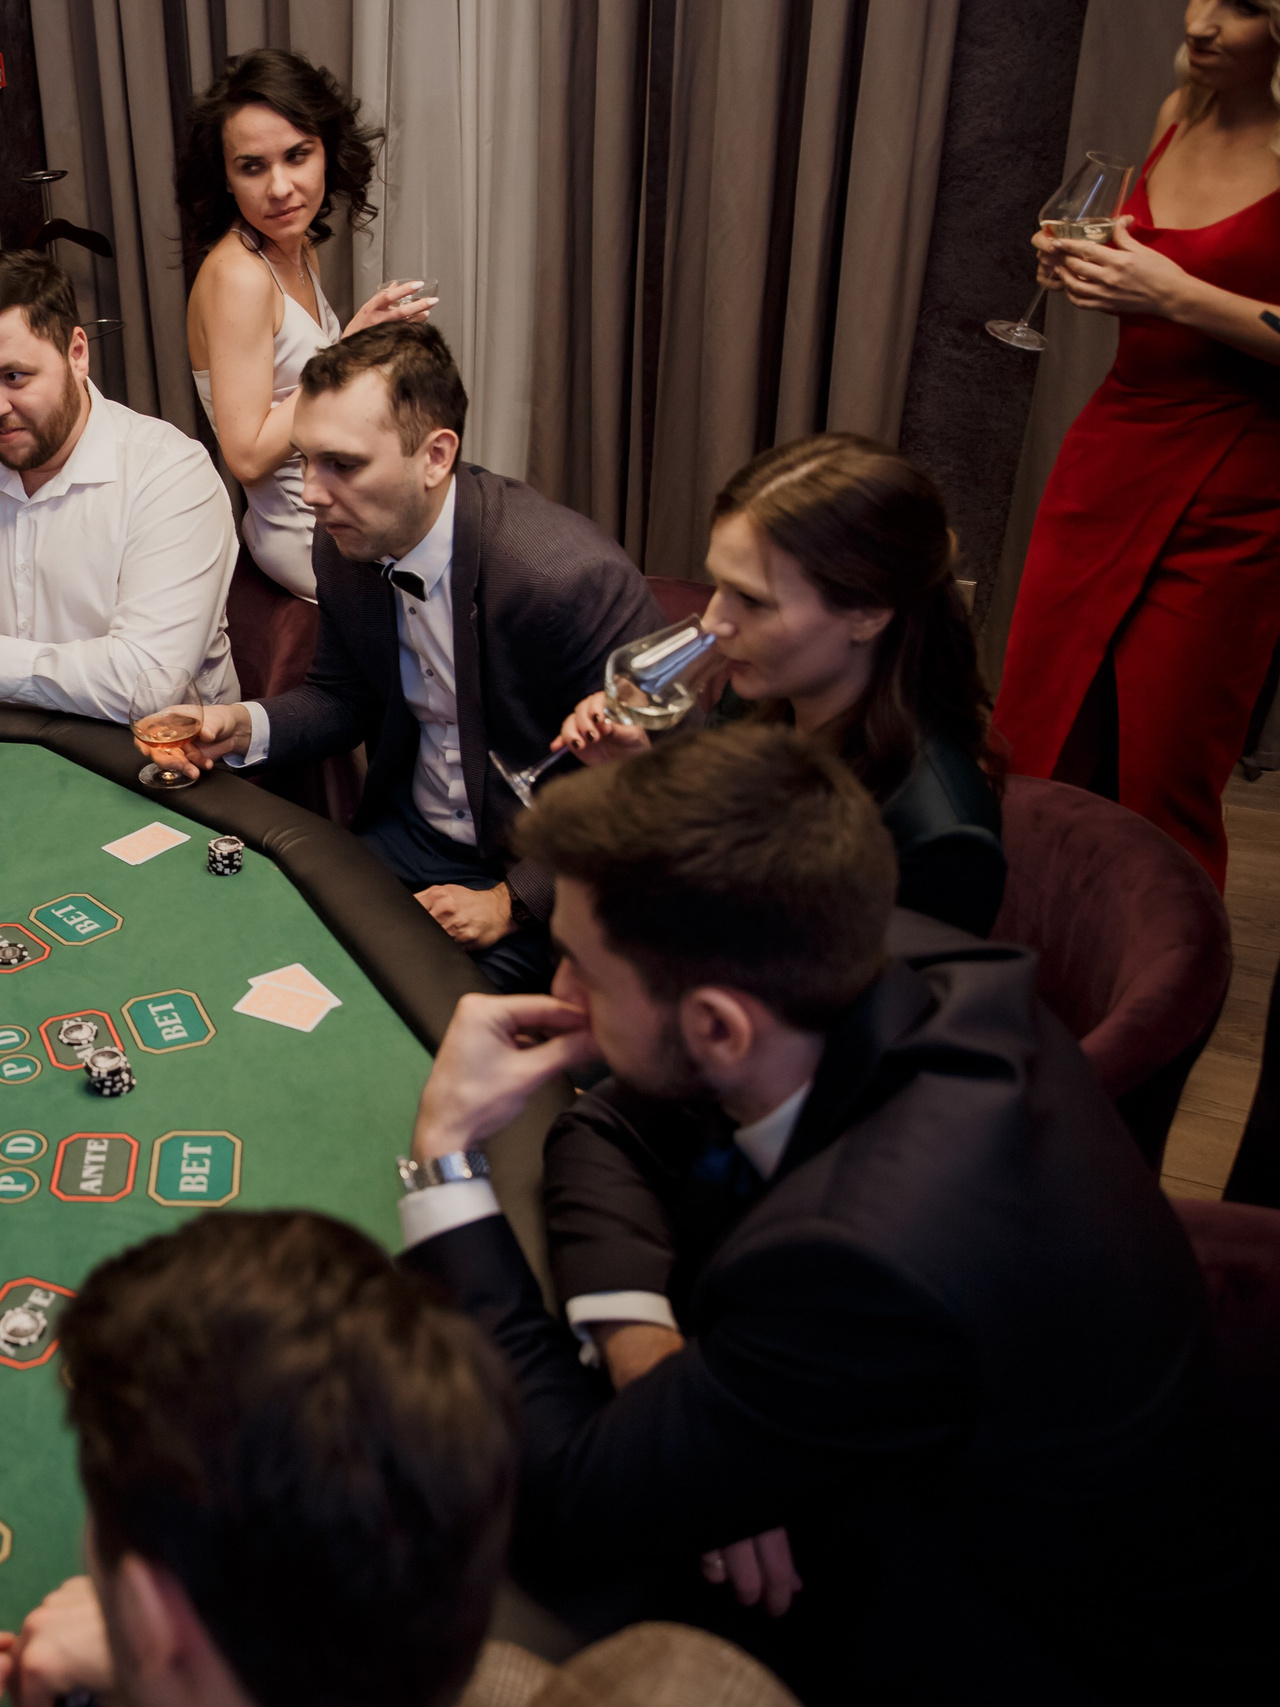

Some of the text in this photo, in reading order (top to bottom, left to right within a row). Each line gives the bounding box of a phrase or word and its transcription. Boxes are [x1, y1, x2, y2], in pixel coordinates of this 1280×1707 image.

[50, 904, 102, 935] BET
[147, 1001, 189, 1042] BET
[2, 1062, 31, 1078] P
[5, 1136, 36, 1154] D
[79, 1138, 109, 1195] ANTE
[178, 1141, 212, 1193] BET
